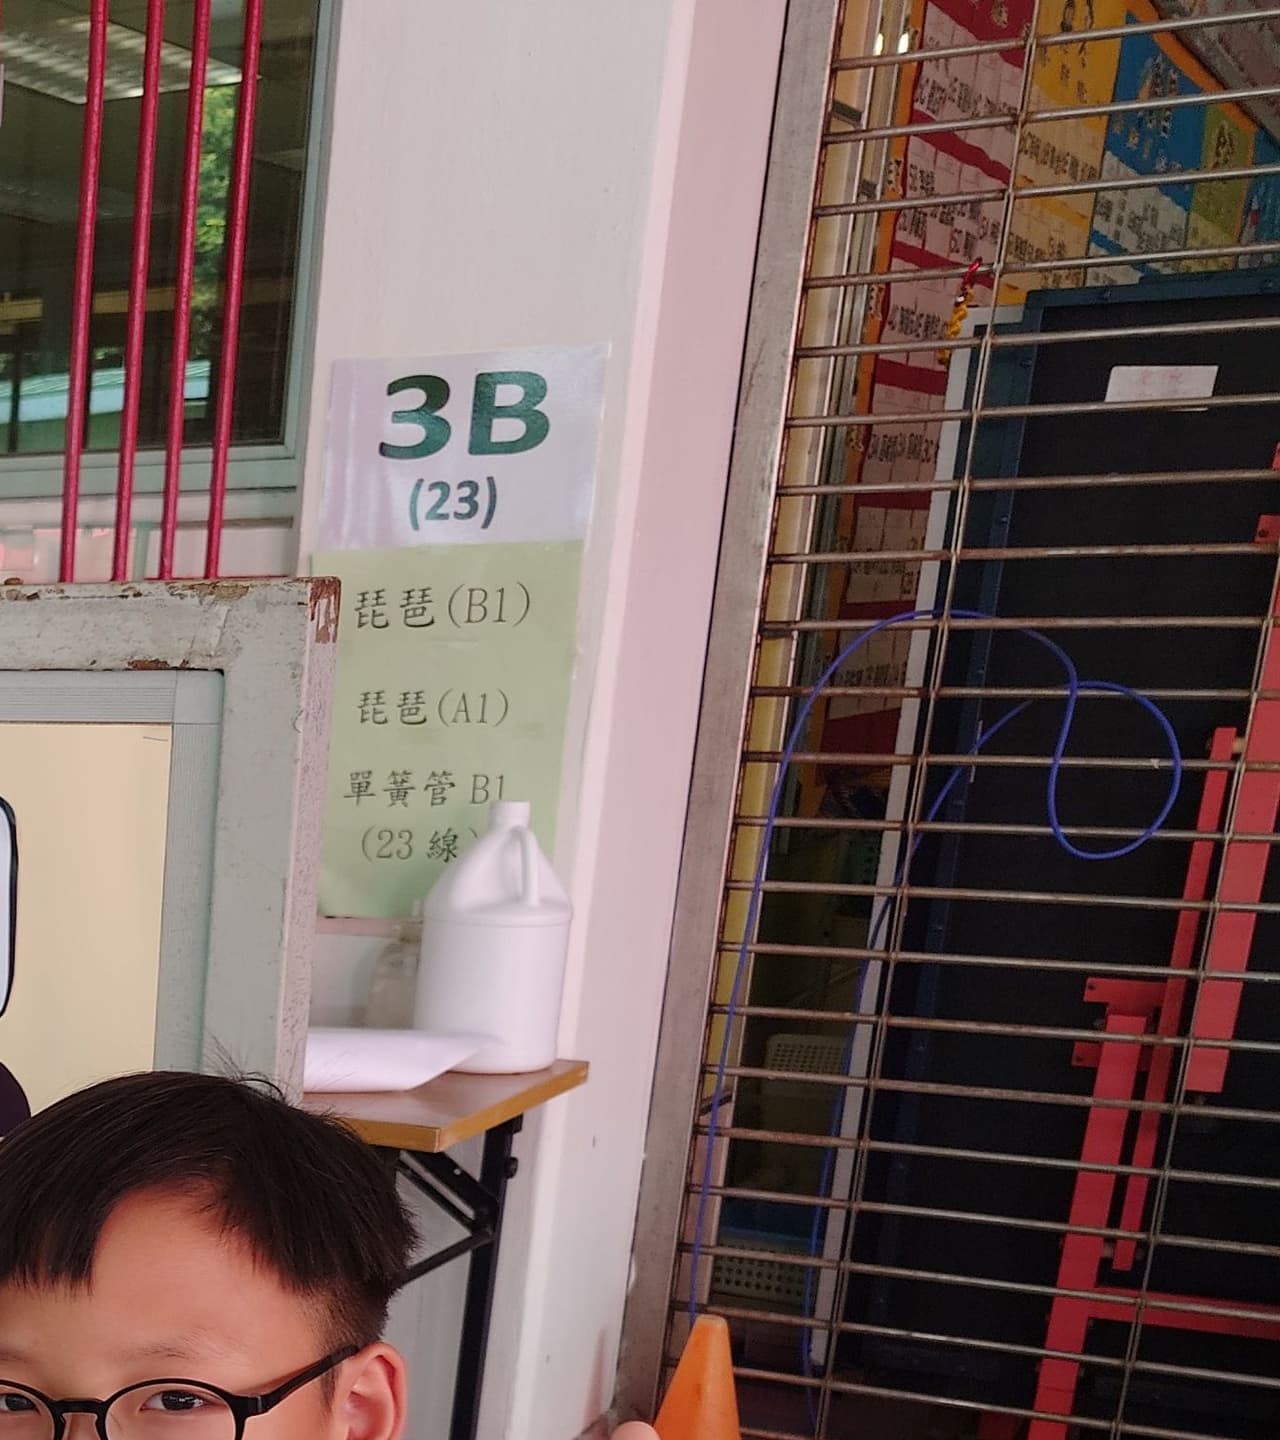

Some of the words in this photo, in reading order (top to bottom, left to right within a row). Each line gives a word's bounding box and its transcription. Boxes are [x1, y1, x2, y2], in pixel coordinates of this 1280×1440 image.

[379, 370, 550, 460] 3B
[409, 476, 498, 530] (23)
[354, 583, 531, 629] 琵琶(B1)
[358, 688, 509, 727] 琵琶(A1)
[470, 774, 504, 805] B1
